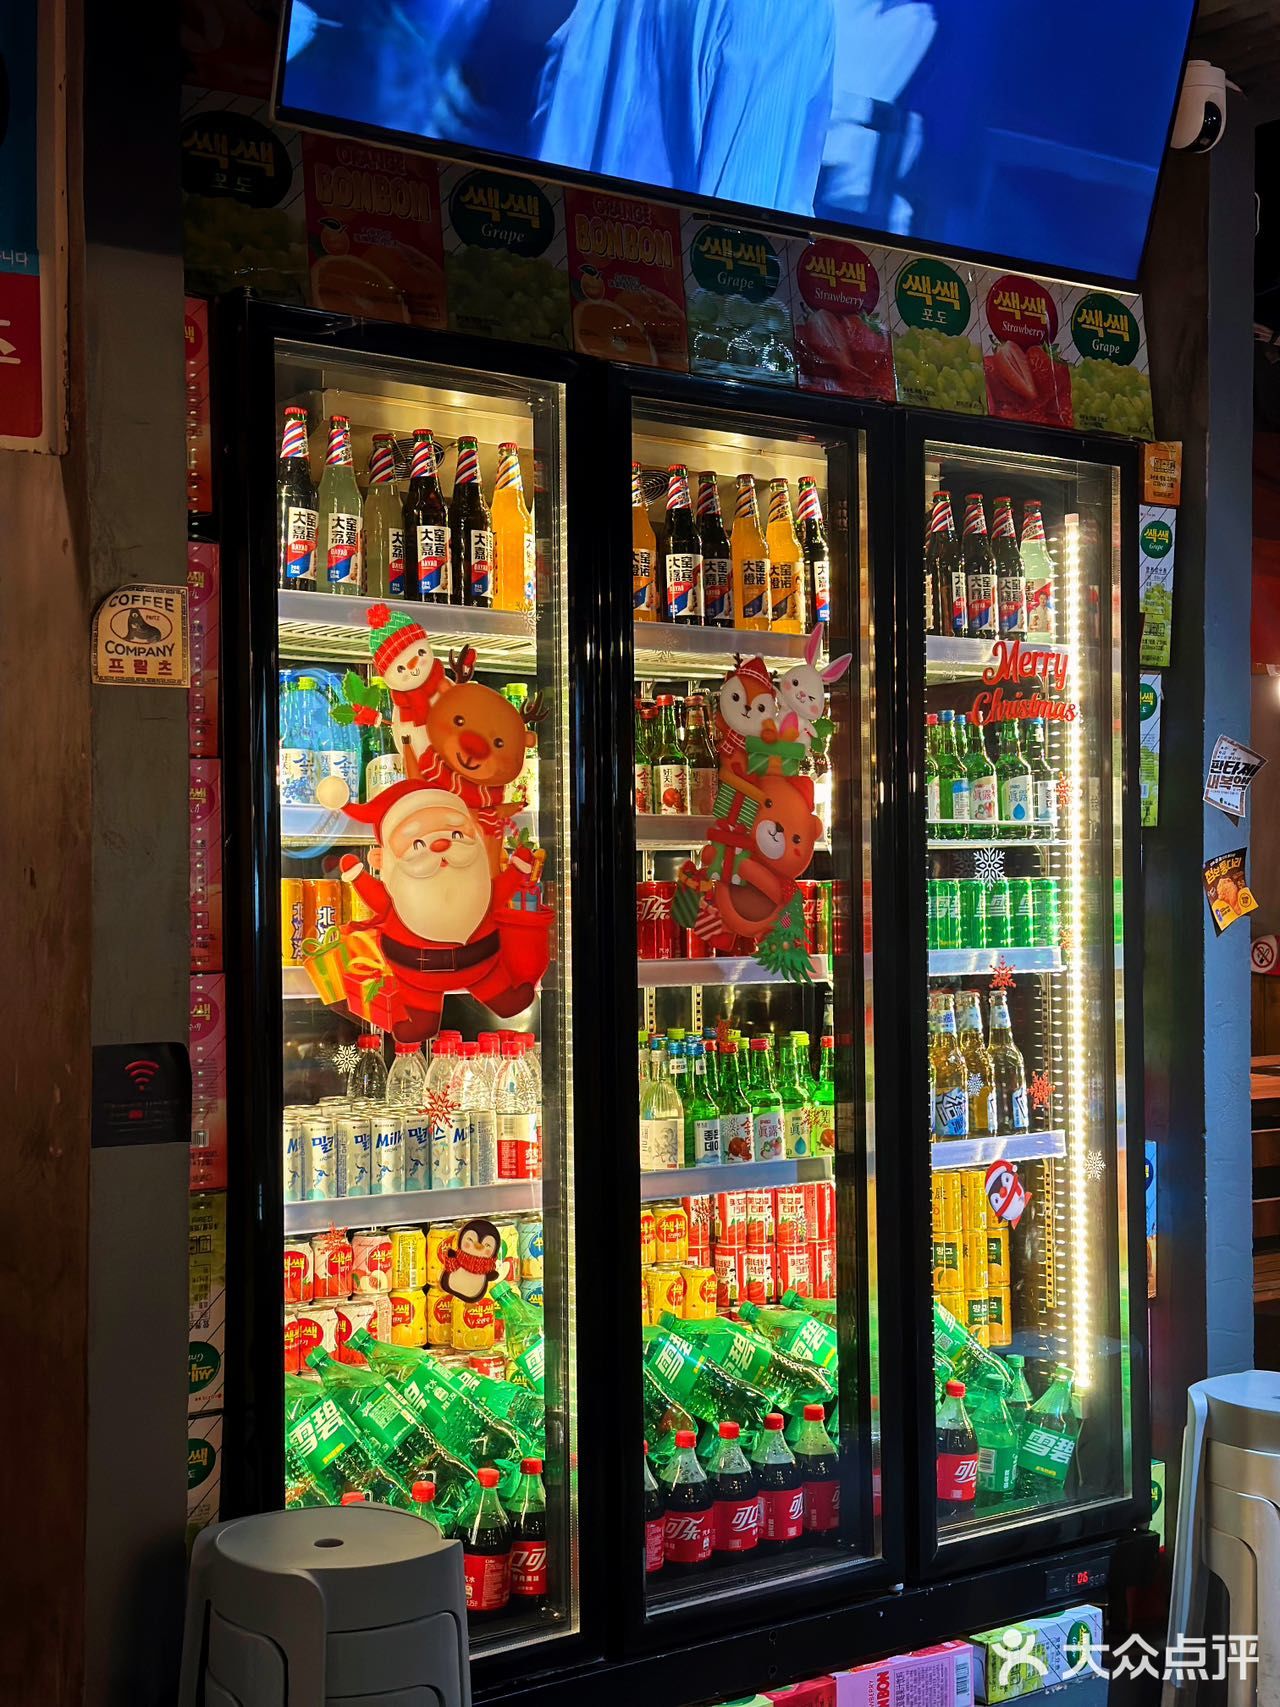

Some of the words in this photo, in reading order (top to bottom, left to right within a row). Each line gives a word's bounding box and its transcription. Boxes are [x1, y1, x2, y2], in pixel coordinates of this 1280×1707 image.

[480, 222, 528, 245] Grape
[717, 271, 755, 290] Grape
[814, 287, 865, 308] Strawberry
[921, 307, 948, 325] 포도
[1001, 319, 1046, 339] Strawberry
[1092, 337, 1121, 355] Grape
[421, 529, 445, 543] 大窑
[743, 560, 765, 573] 大窑
[108, 593, 175, 613] COFFEE
[105, 640, 175, 657] COMPANY
[982, 639, 1069, 691] Merry
[970, 687, 1076, 727] Christmas
[704, 1129, 719, 1142] 좋은
[704, 1140, 719, 1152] 데이
[655, 1332, 694, 1384] 雪碧
[287, 1399, 346, 1458] 雪碧
[1023, 1429, 1076, 1465] 雪碧
[664, 1516, 705, 1541] 可乐
